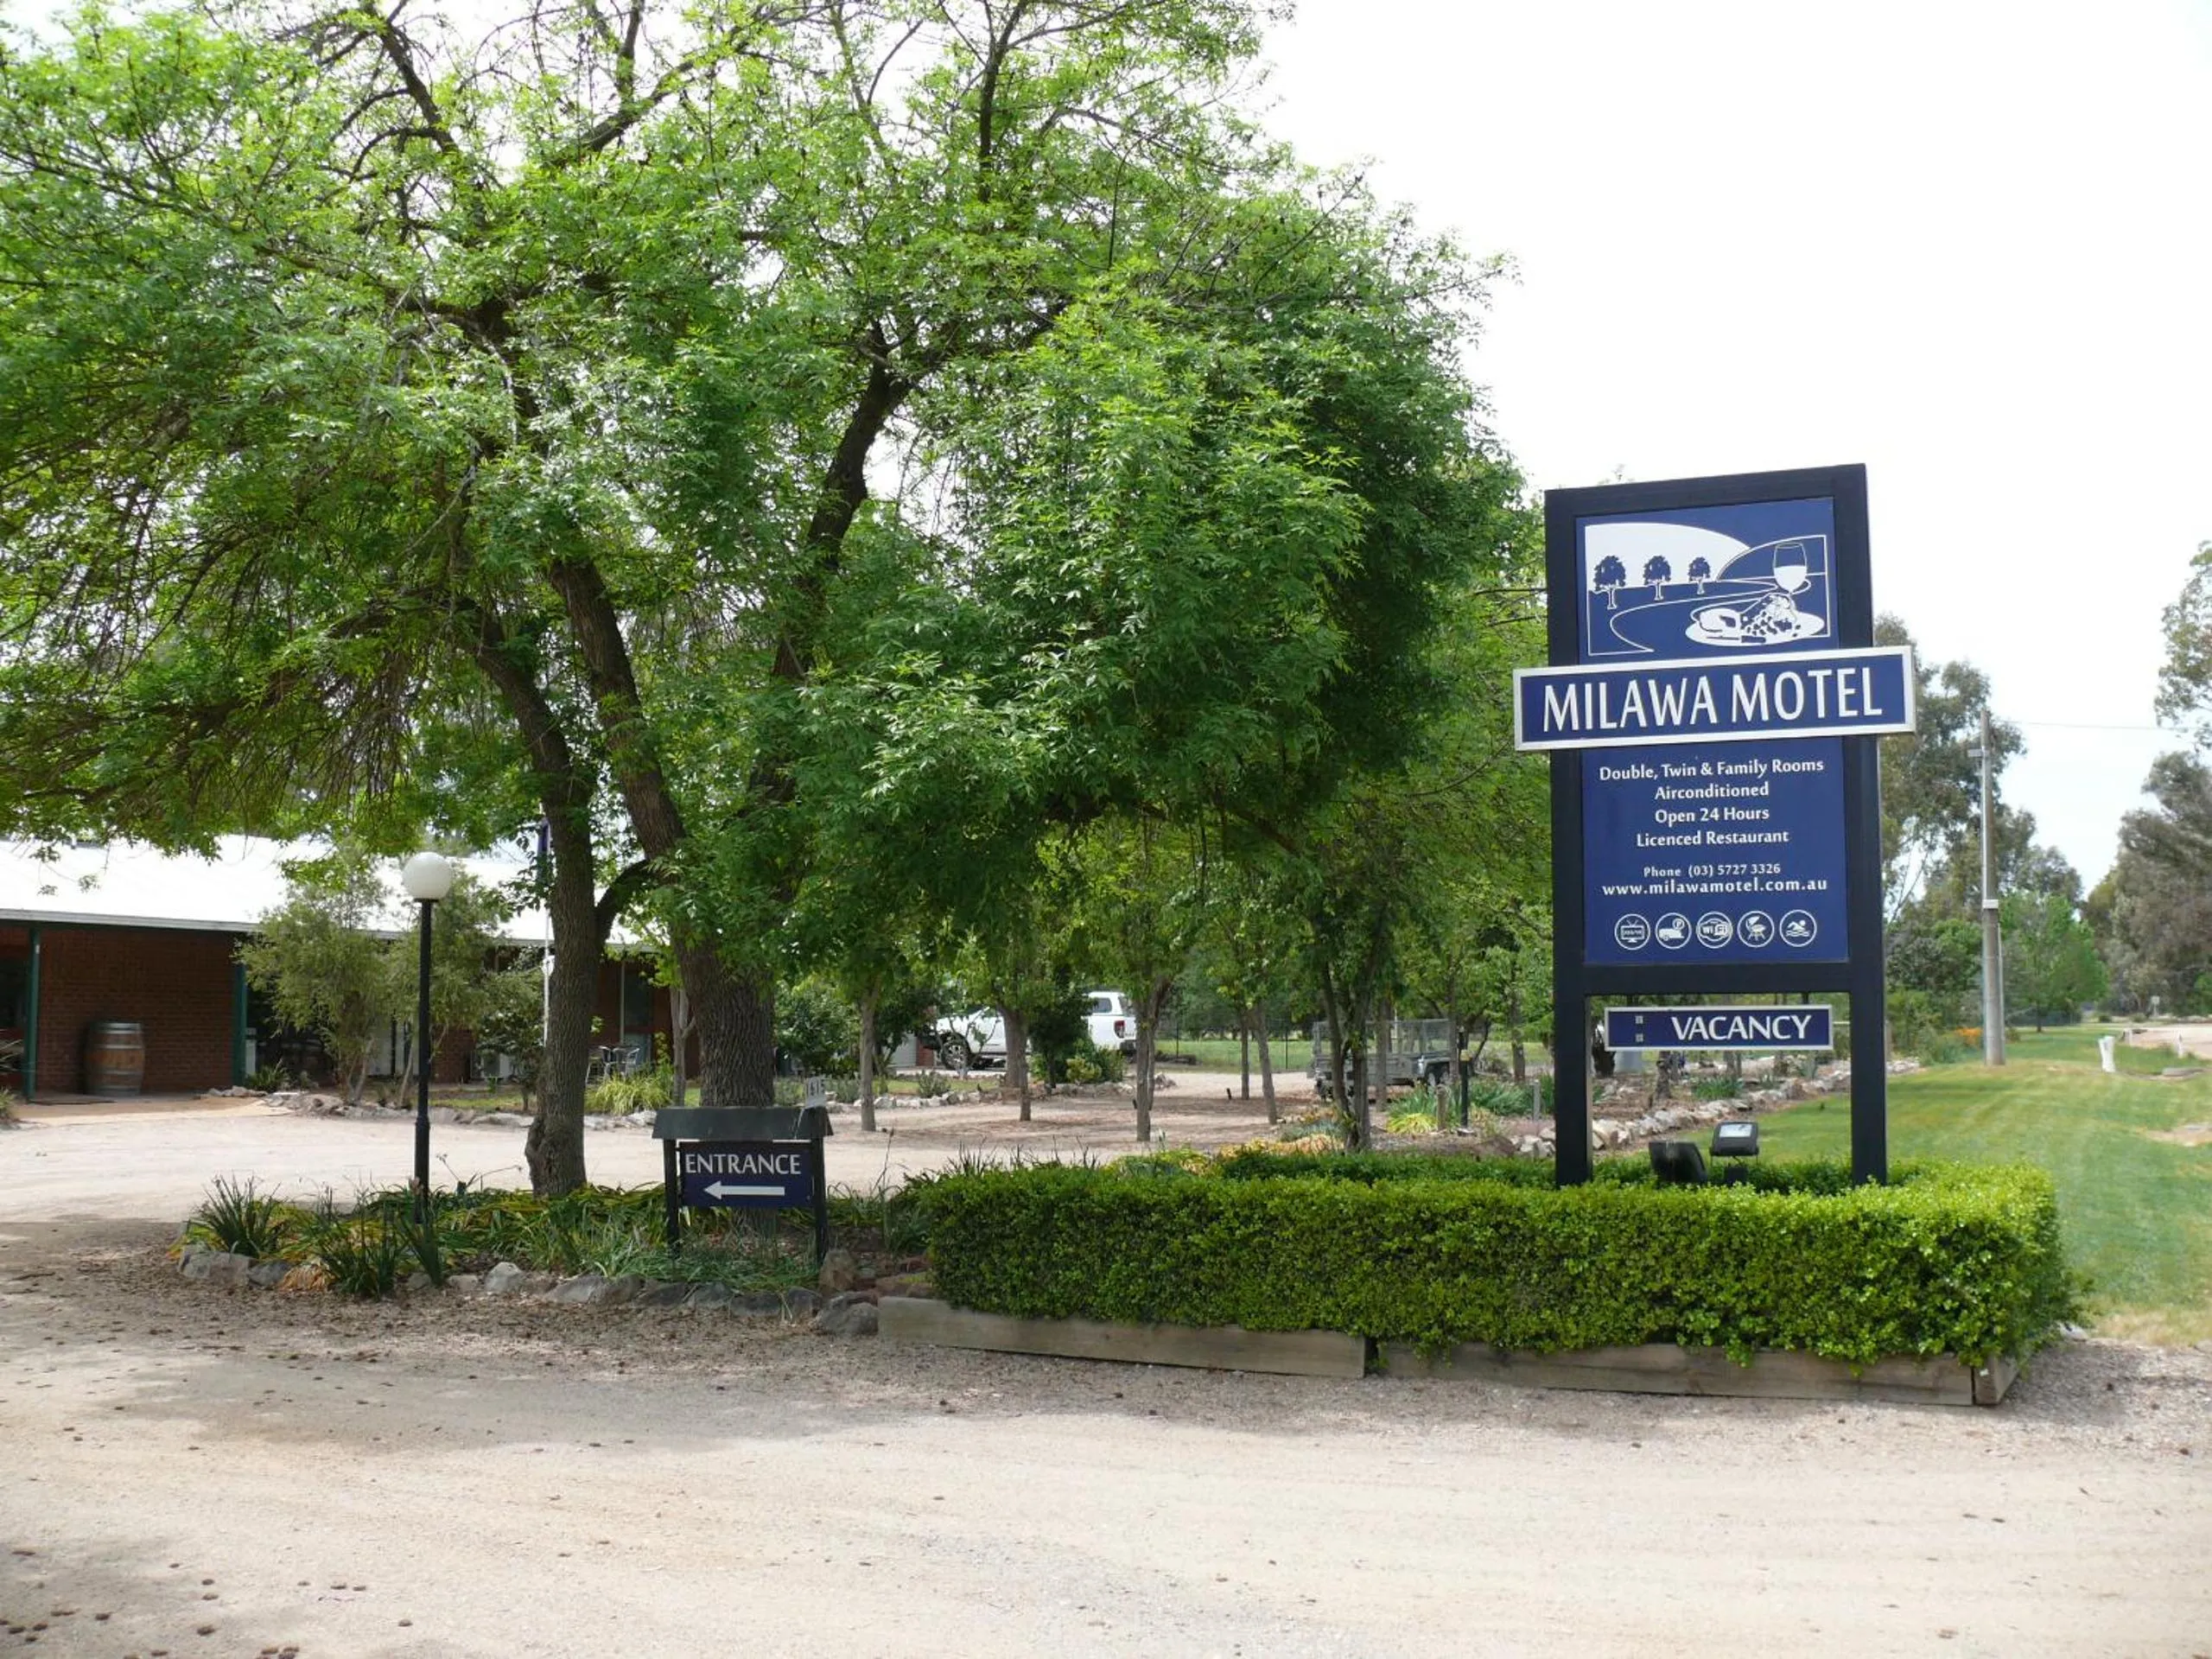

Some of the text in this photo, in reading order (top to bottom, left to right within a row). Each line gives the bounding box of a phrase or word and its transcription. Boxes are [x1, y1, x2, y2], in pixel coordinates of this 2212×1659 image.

[1542, 667, 1883, 733] MILAWA MOTEL
[1599, 760, 1824, 780] Double, Twin & Family Rooms
[1655, 781, 1769, 799] Airconditioned
[1655, 806, 1770, 827] Open 24 Hours
[1637, 830, 1789, 846] Licenced Restaurant
[1643, 863, 1781, 878] Phone (03) 5727 3326
[1602, 877, 1827, 895] www.milawamotel.com.au
[1670, 1014, 1812, 1040] VACANCY
[685, 1154, 802, 1175] ENTRANCE
